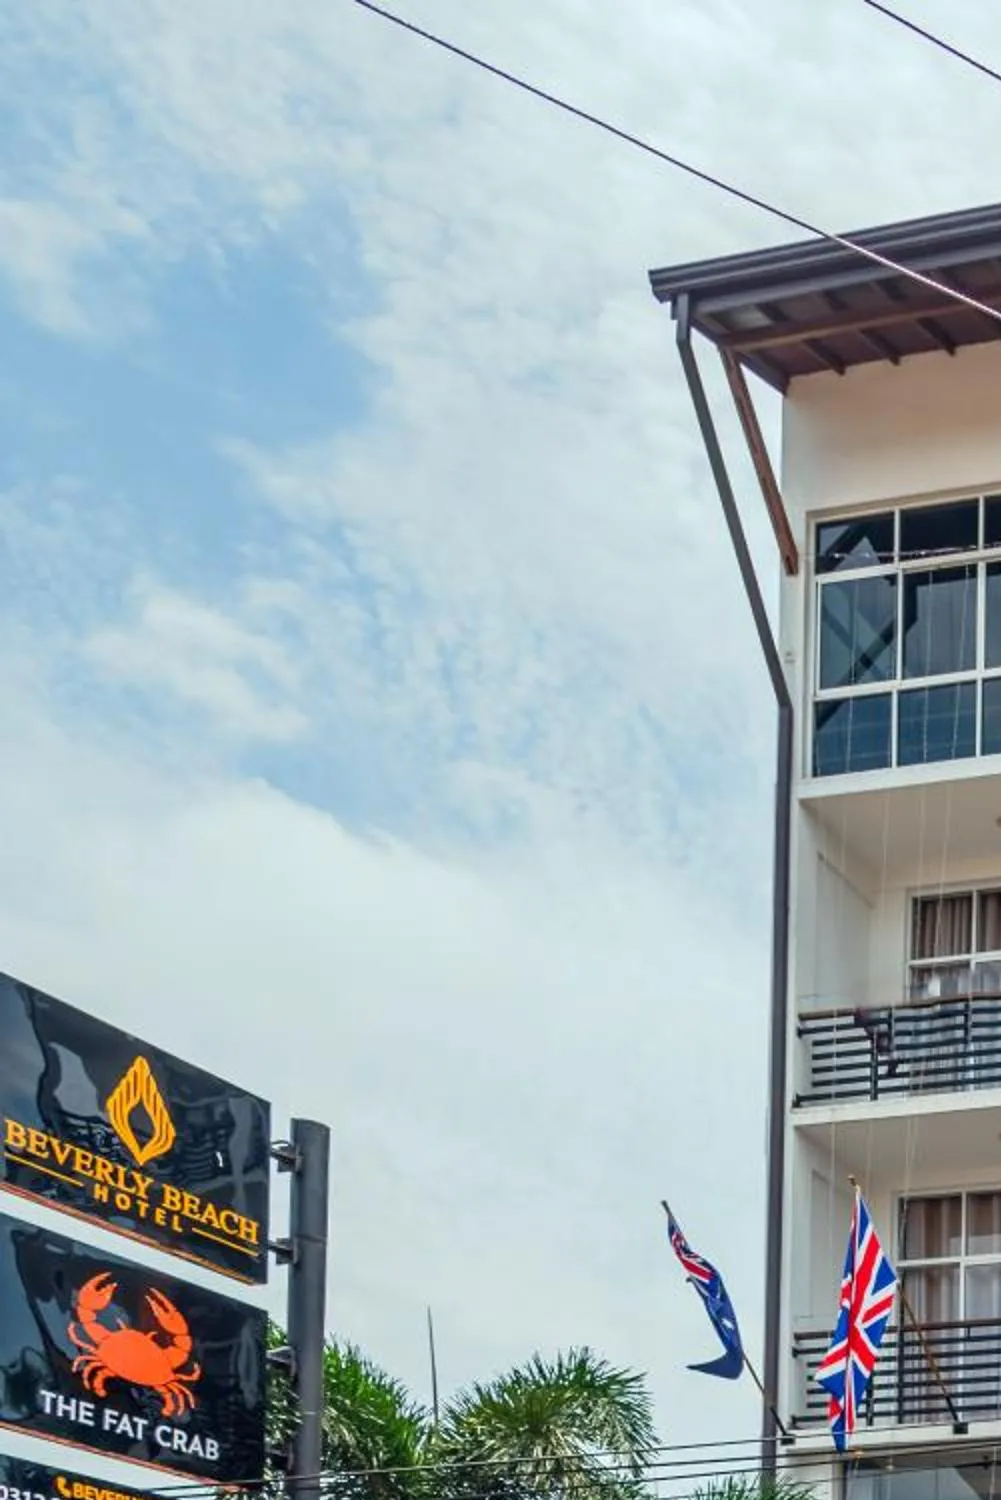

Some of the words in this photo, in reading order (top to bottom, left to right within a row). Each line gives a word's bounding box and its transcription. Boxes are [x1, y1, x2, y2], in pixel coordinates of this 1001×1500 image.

[4, 1118, 154, 1199] BEVERLY
[163, 1184, 259, 1244] BEACH
[93, 1183, 183, 1233] HOTEL
[40, 1389, 95, 1426] THE
[103, 1409, 148, 1442] FAT
[155, 1424, 220, 1462] CRAB
